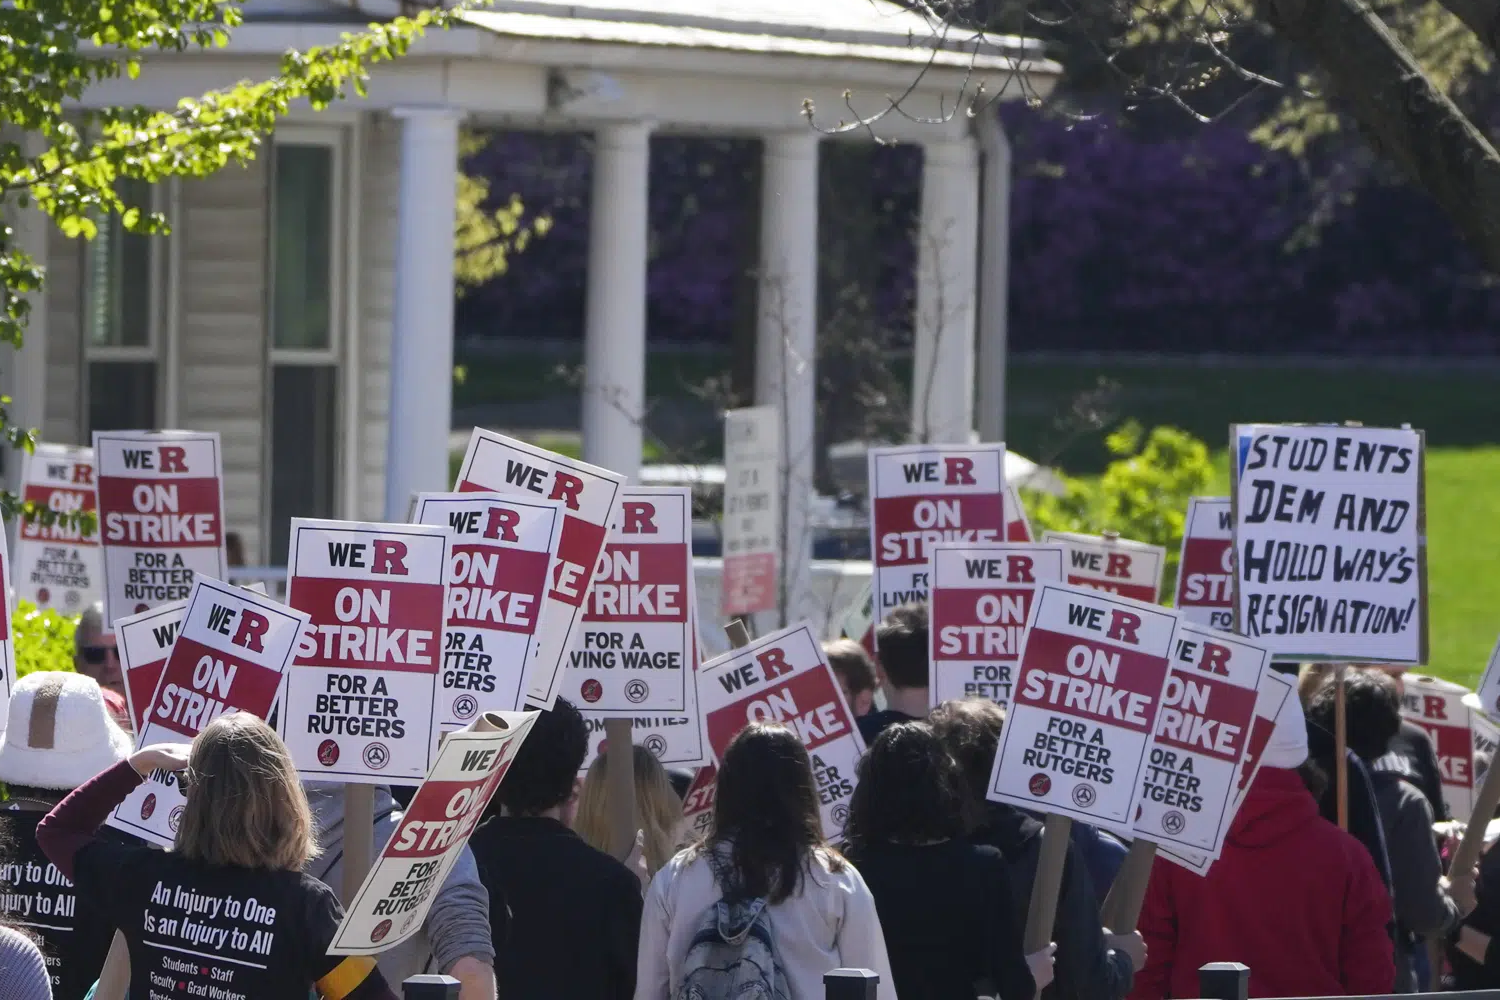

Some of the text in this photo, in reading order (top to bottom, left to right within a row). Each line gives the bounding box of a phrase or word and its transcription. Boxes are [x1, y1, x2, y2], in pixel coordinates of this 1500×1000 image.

[122, 446, 189, 473] WE R
[1247, 434, 1412, 474] STUDENTS
[47, 463, 93, 485] WE R
[505, 459, 584, 511] WE R
[903, 457, 977, 486] WE R
[48, 491, 83, 514] ON
[132, 484, 179, 513] ON
[913, 499, 961, 529] ON
[1245, 480, 1410, 534] DEMAND
[106, 512, 216, 543] STRIKE
[450, 506, 521, 543] WE R
[622, 502, 658, 535] R
[36, 560, 87, 574] BETTER
[135, 552, 184, 568] FOR A
[328, 539, 409, 576] WE R
[450, 551, 499, 586] ON
[965, 555, 1035, 583] WE R
[1071, 550, 1132, 578] WE R
[1243, 539, 1416, 585] HOLLOWAY'S
[30, 572, 90, 589] RUTGERS
[128, 568, 194, 585] BETTER
[334, 586, 391, 625] ON
[447, 587, 534, 627] RIKE
[586, 584, 681, 616] RIKE
[975, 594, 1024, 624] ON
[207, 603, 270, 654] WE R
[1068, 603, 1142, 645] WE R
[1246, 594, 1416, 638] RESIGNATION!
[296, 623, 433, 666] STRIKE
[471, 633, 484, 652] A
[585, 632, 645, 650] FOR A
[621, 651, 681, 669] WAGE
[718, 647, 794, 694] WE R
[973, 666, 1011, 682] FOR
[1066, 644, 1121, 685] ON
[1197, 641, 1232, 677] R
[192, 654, 238, 700] ON
[327, 674, 388, 696] FOR A
[316, 694, 399, 718] BETTER
[746, 688, 799, 722] ON
[1022, 669, 1152, 726] STRIKE
[1163, 676, 1211, 716] ON
[1423, 695, 1448, 720] R
[307, 715, 406, 739] RUTGERS
[1047, 716, 1104, 746] FOR A
[1158, 708, 1241, 756] RIKE
[460, 749, 497, 771] WE
[1033, 732, 1111, 765] BETTER
[1022, 748, 1114, 785] RUTGERS
[1181, 756, 1194, 775] A
[445, 783, 487, 818] ON
[1143, 782, 1203, 813] TGERS
[25, 862, 42, 883] to
[406, 860, 438, 880] FOR
[36, 892, 76, 917] to All
[150, 881, 276, 926] An Injury to One
[144, 909, 274, 956] Is an Injury to All
[162, 956, 234, 982] Students Staff
[150, 971, 246, 1000] Faculty Grad Workers
